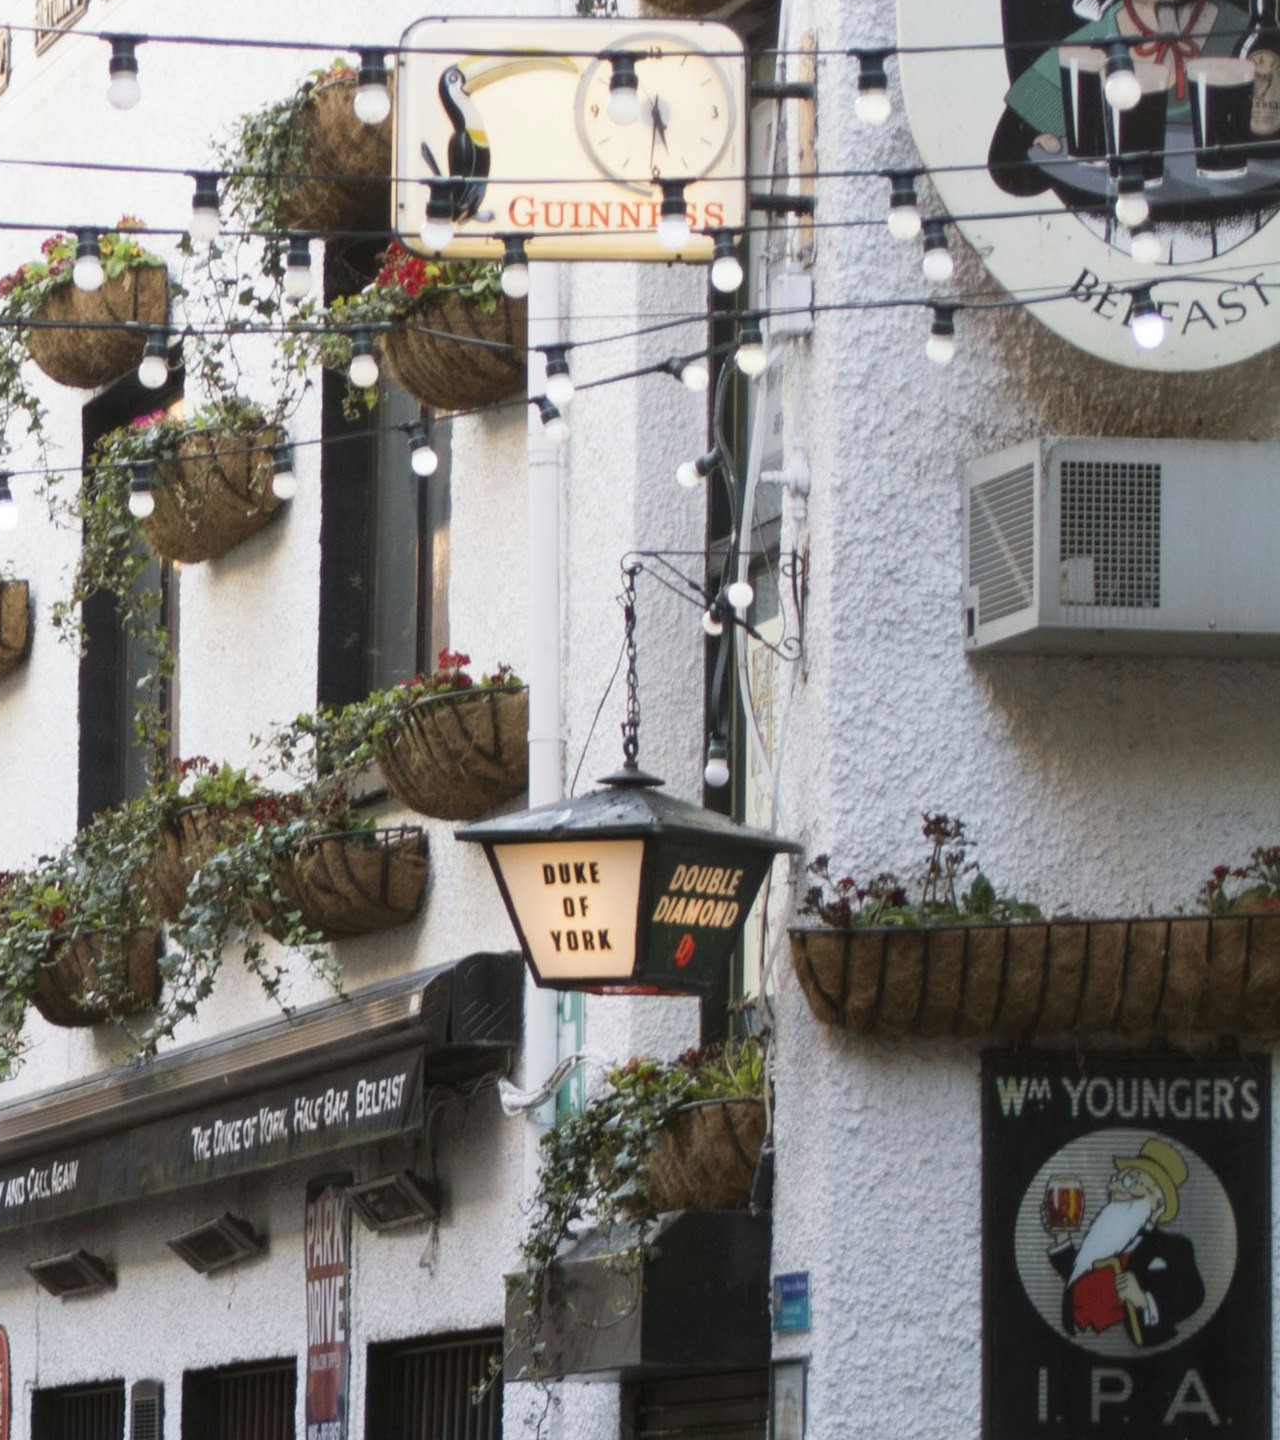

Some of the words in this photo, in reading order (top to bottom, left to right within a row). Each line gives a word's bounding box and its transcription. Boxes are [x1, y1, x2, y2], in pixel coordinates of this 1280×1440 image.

[543, 862, 600, 885] DUKE
[668, 864, 744, 897] DOUBLE
[562, 895, 589, 918] OF
[652, 895, 739, 928] DIAMOND
[550, 928, 612, 952] YORK
[212, 1119, 243, 1156] DUKE
[355, 1073, 406, 1120] BELFAST
[1061, 1075, 1261, 1121] YOUNGER'S
[50, 1159, 80, 1198] AGAIN
[305, 1195, 347, 1268] PARK
[307, 1274, 346, 1347] DRIVE
